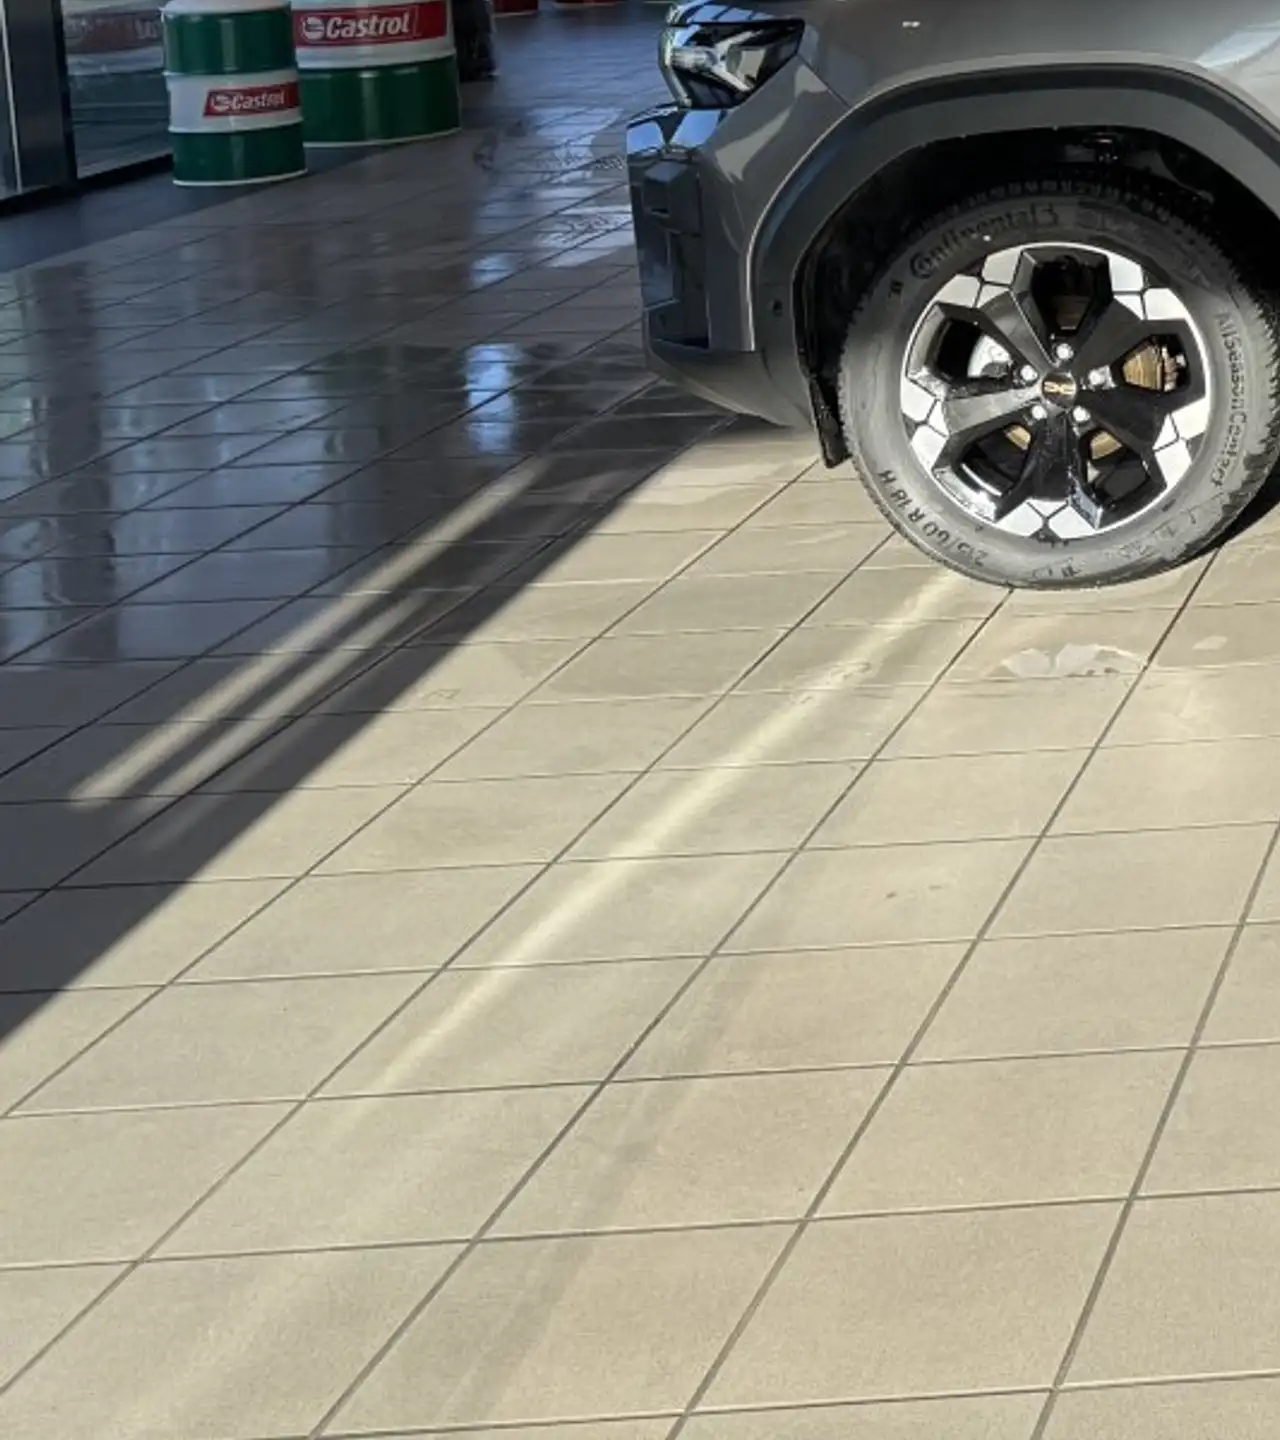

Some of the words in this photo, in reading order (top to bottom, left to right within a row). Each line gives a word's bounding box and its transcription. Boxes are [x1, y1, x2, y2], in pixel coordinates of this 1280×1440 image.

[326, 12, 408, 38] Castrol
[231, 91, 284, 111] Castrol
[878, 469, 897, 485] H
[907, 507, 925, 526] R
